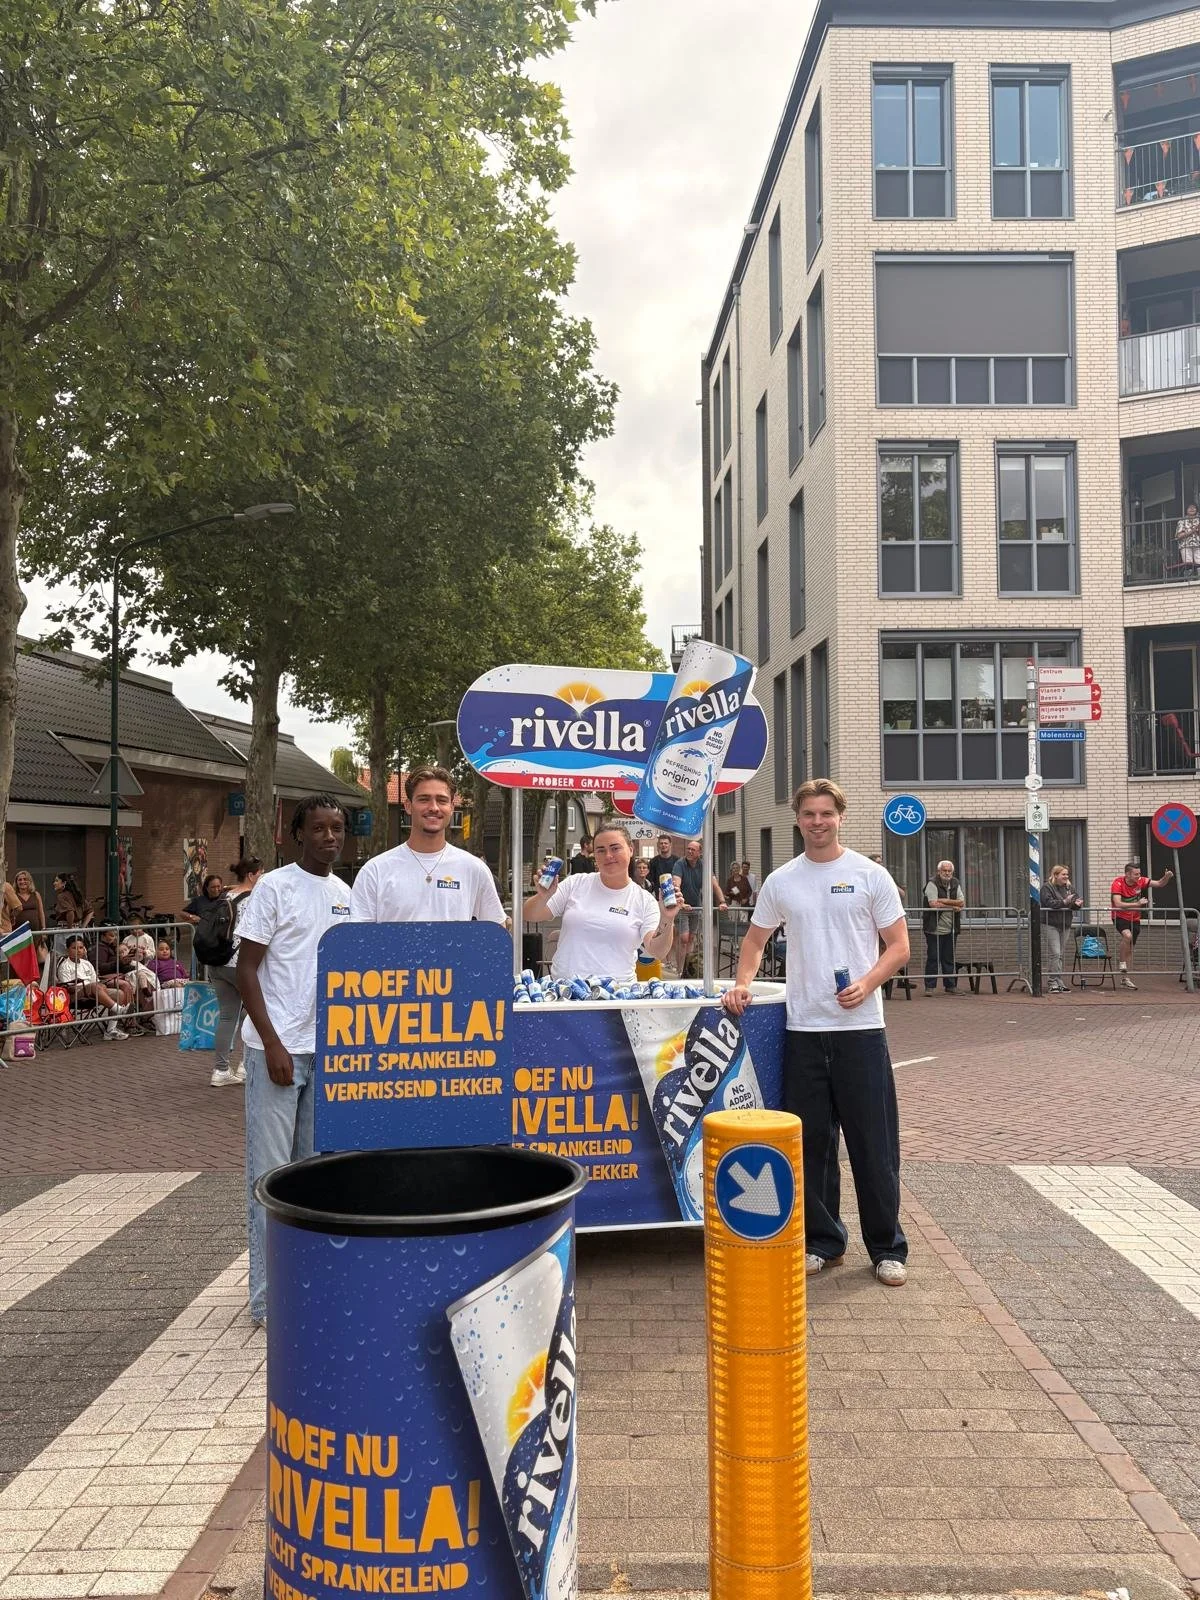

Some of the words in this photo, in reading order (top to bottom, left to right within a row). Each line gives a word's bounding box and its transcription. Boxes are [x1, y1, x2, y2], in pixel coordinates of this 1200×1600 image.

[665, 689, 739, 738] rivella
[510, 707, 646, 752] rivella
[707, 736, 724, 745] ADDED
[532, 776, 575, 787] PROBEER
[580, 779, 615, 788] GRATIS
[662, 768, 699, 788] original
[358, 814, 366, 824] P
[327, 970, 409, 998] PROEF
[416, 968, 452, 996] NU
[326, 1000, 506, 1046] RIVELLA!
[324, 1053, 372, 1073] LICHT
[378, 1050, 497, 1072] SPRANKELEND
[324, 1080, 438, 1102] VERFRISSEND
[441, 1077, 503, 1097] LEKKER
[514, 1068, 556, 1092] OEF
[562, 1066, 594, 1091] NU
[663, 1017, 740, 1148] rivella
[512, 1094, 640, 1135] IVELLA!
[730, 1092, 752, 1107] ADDED
[270, 1400, 336, 1470] PROEF
[346, 1433, 398, 1478] NU
[269, 1450, 481, 1554] RIVELLA!
[300, 1552, 469, 1594] SPRANKELEND
